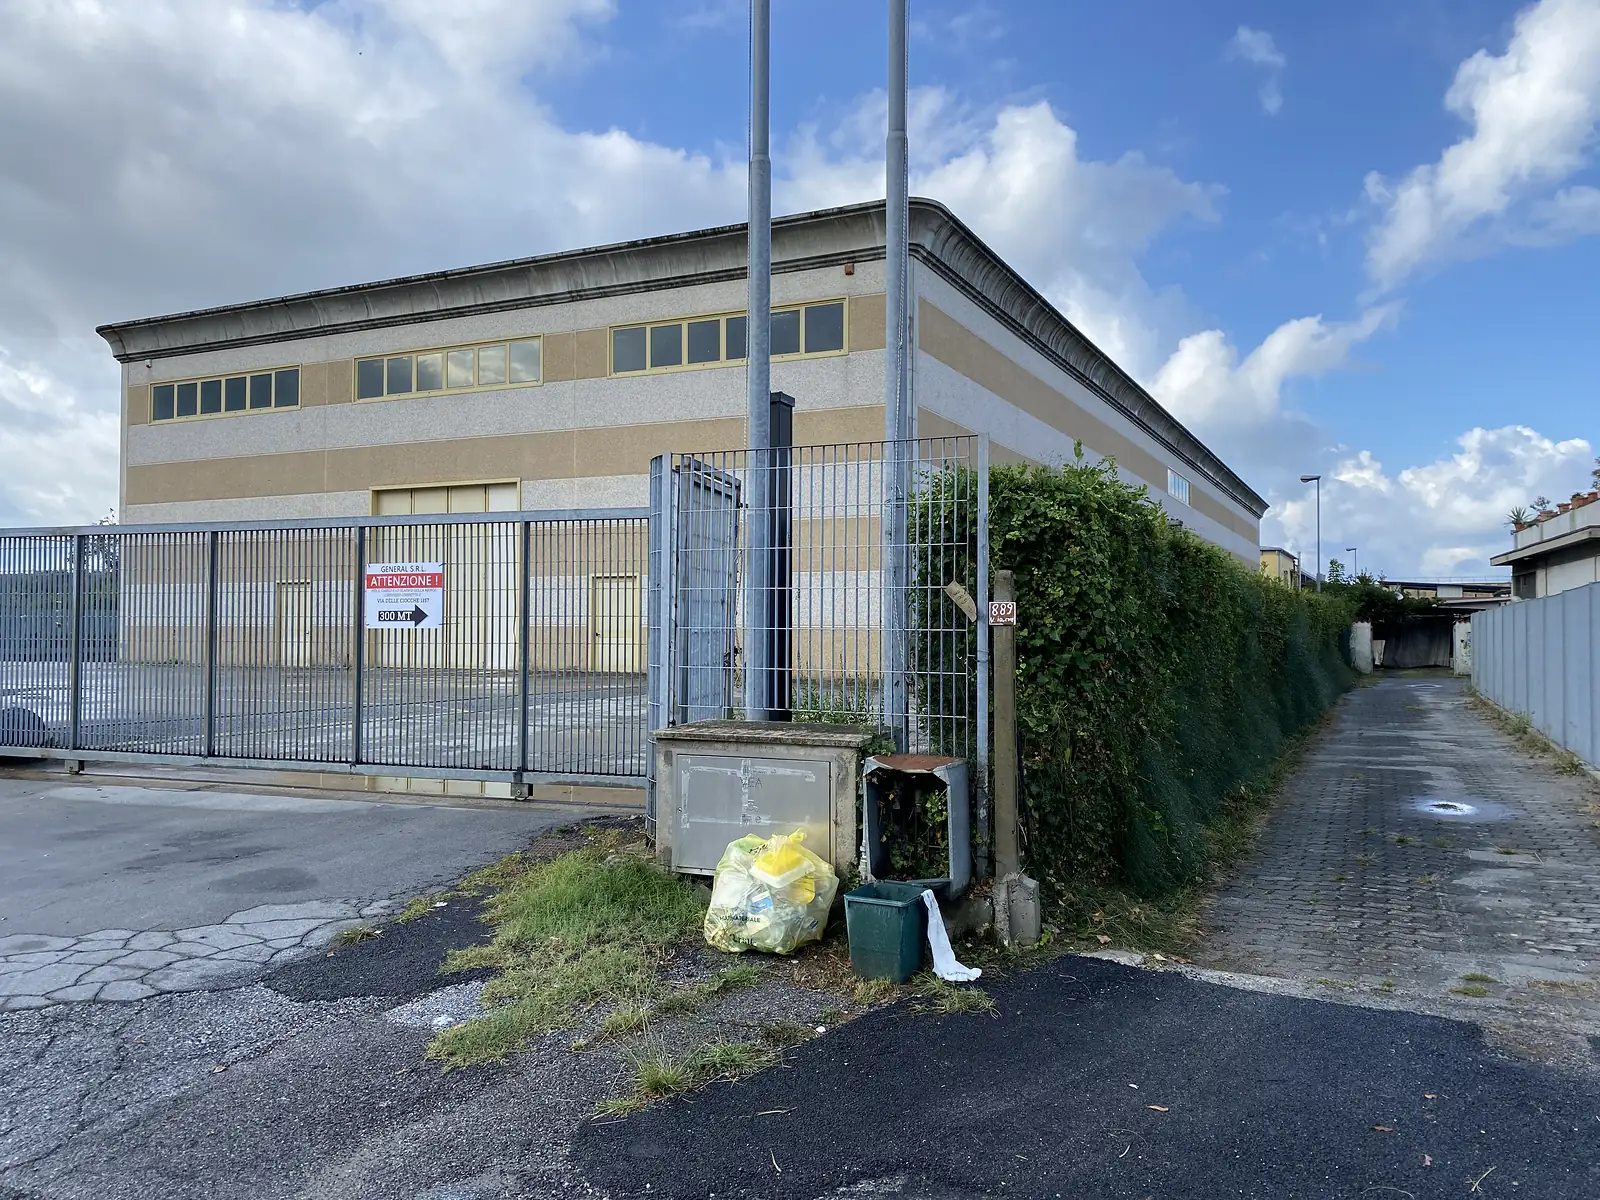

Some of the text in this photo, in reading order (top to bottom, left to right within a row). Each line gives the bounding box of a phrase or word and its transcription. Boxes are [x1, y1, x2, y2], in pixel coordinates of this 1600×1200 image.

[370, 576, 432, 586] ATTENZIONE
[992, 603, 1013, 615] 889
[380, 611, 412, 621] 300 MT
